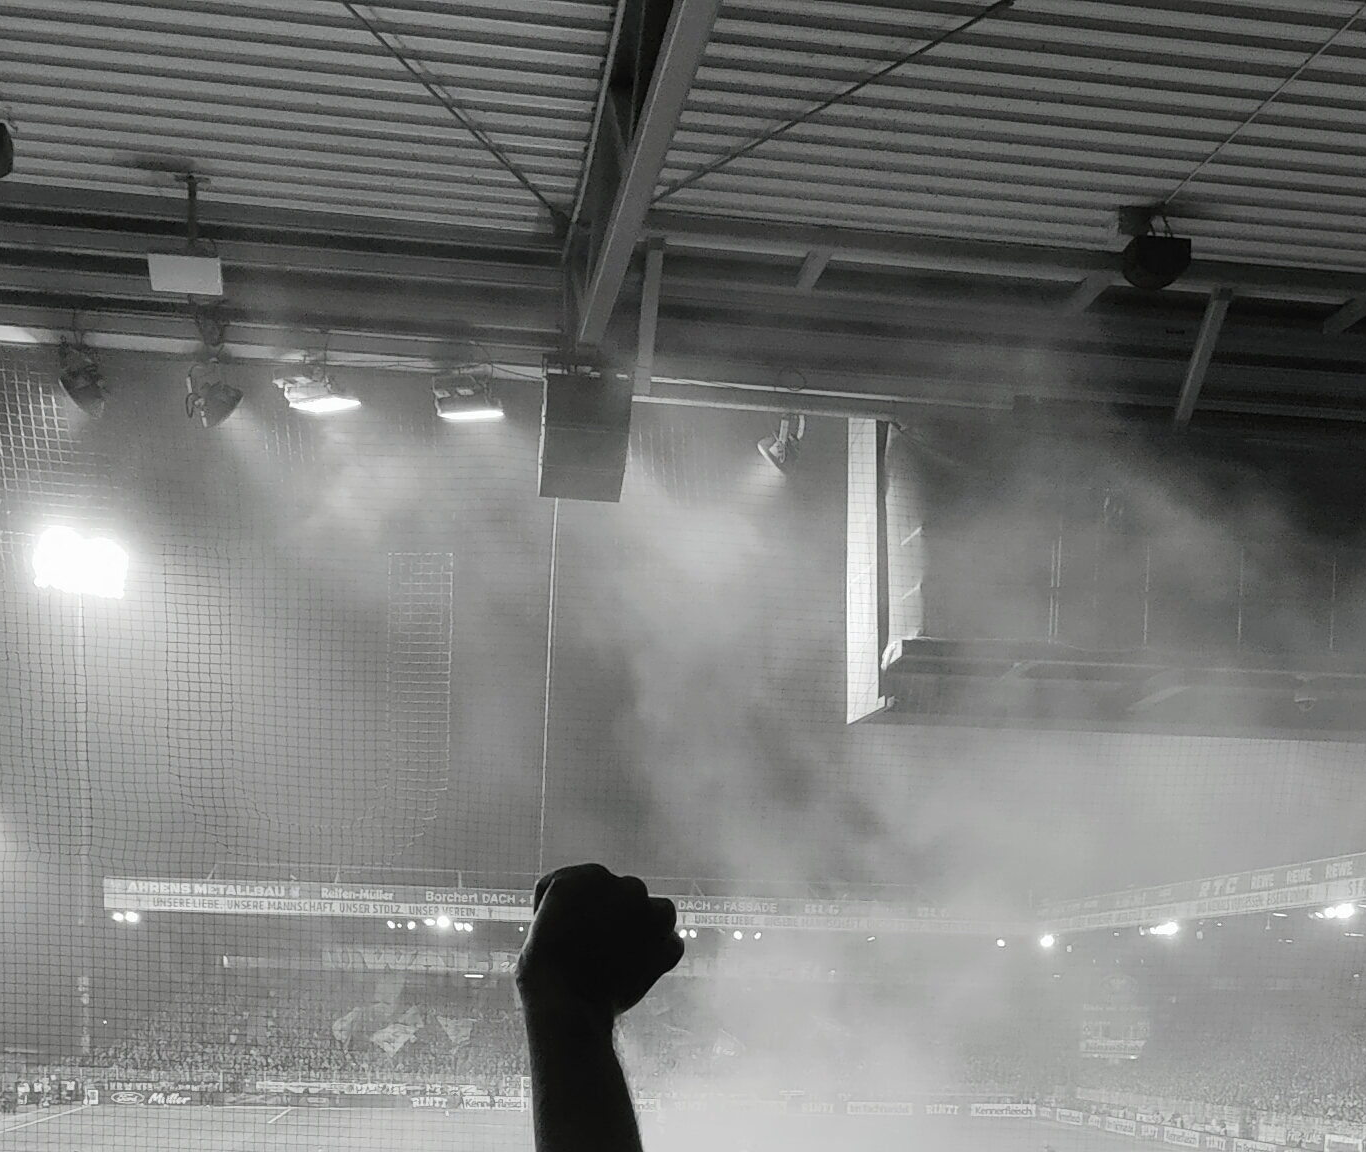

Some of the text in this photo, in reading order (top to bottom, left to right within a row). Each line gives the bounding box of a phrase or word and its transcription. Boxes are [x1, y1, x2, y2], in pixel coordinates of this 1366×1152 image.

[1286, 867, 1313, 884] REWE
[1325, 860, 1353, 879] REWE
[1250, 872, 1275, 890] REWE
[127, 881, 286, 898] AHRENS METALLBAU
[320, 887, 395, 901] Reifen-Müller
[425, 890, 479, 903] Borchert
[482, 894, 516, 905] DACH
[152, 897, 191, 909] UNSERE
[227, 899, 264, 911] UNSERE
[340, 902, 370, 914] UNSER
[678, 900, 711, 912] DACH
[724, 901, 777, 914] FASSADE
[694, 913, 730, 925] UNSERE
[465, 1097, 528, 1110] Kennrfleisch
[975, 1104, 1034, 1117] Kennerfleisch
